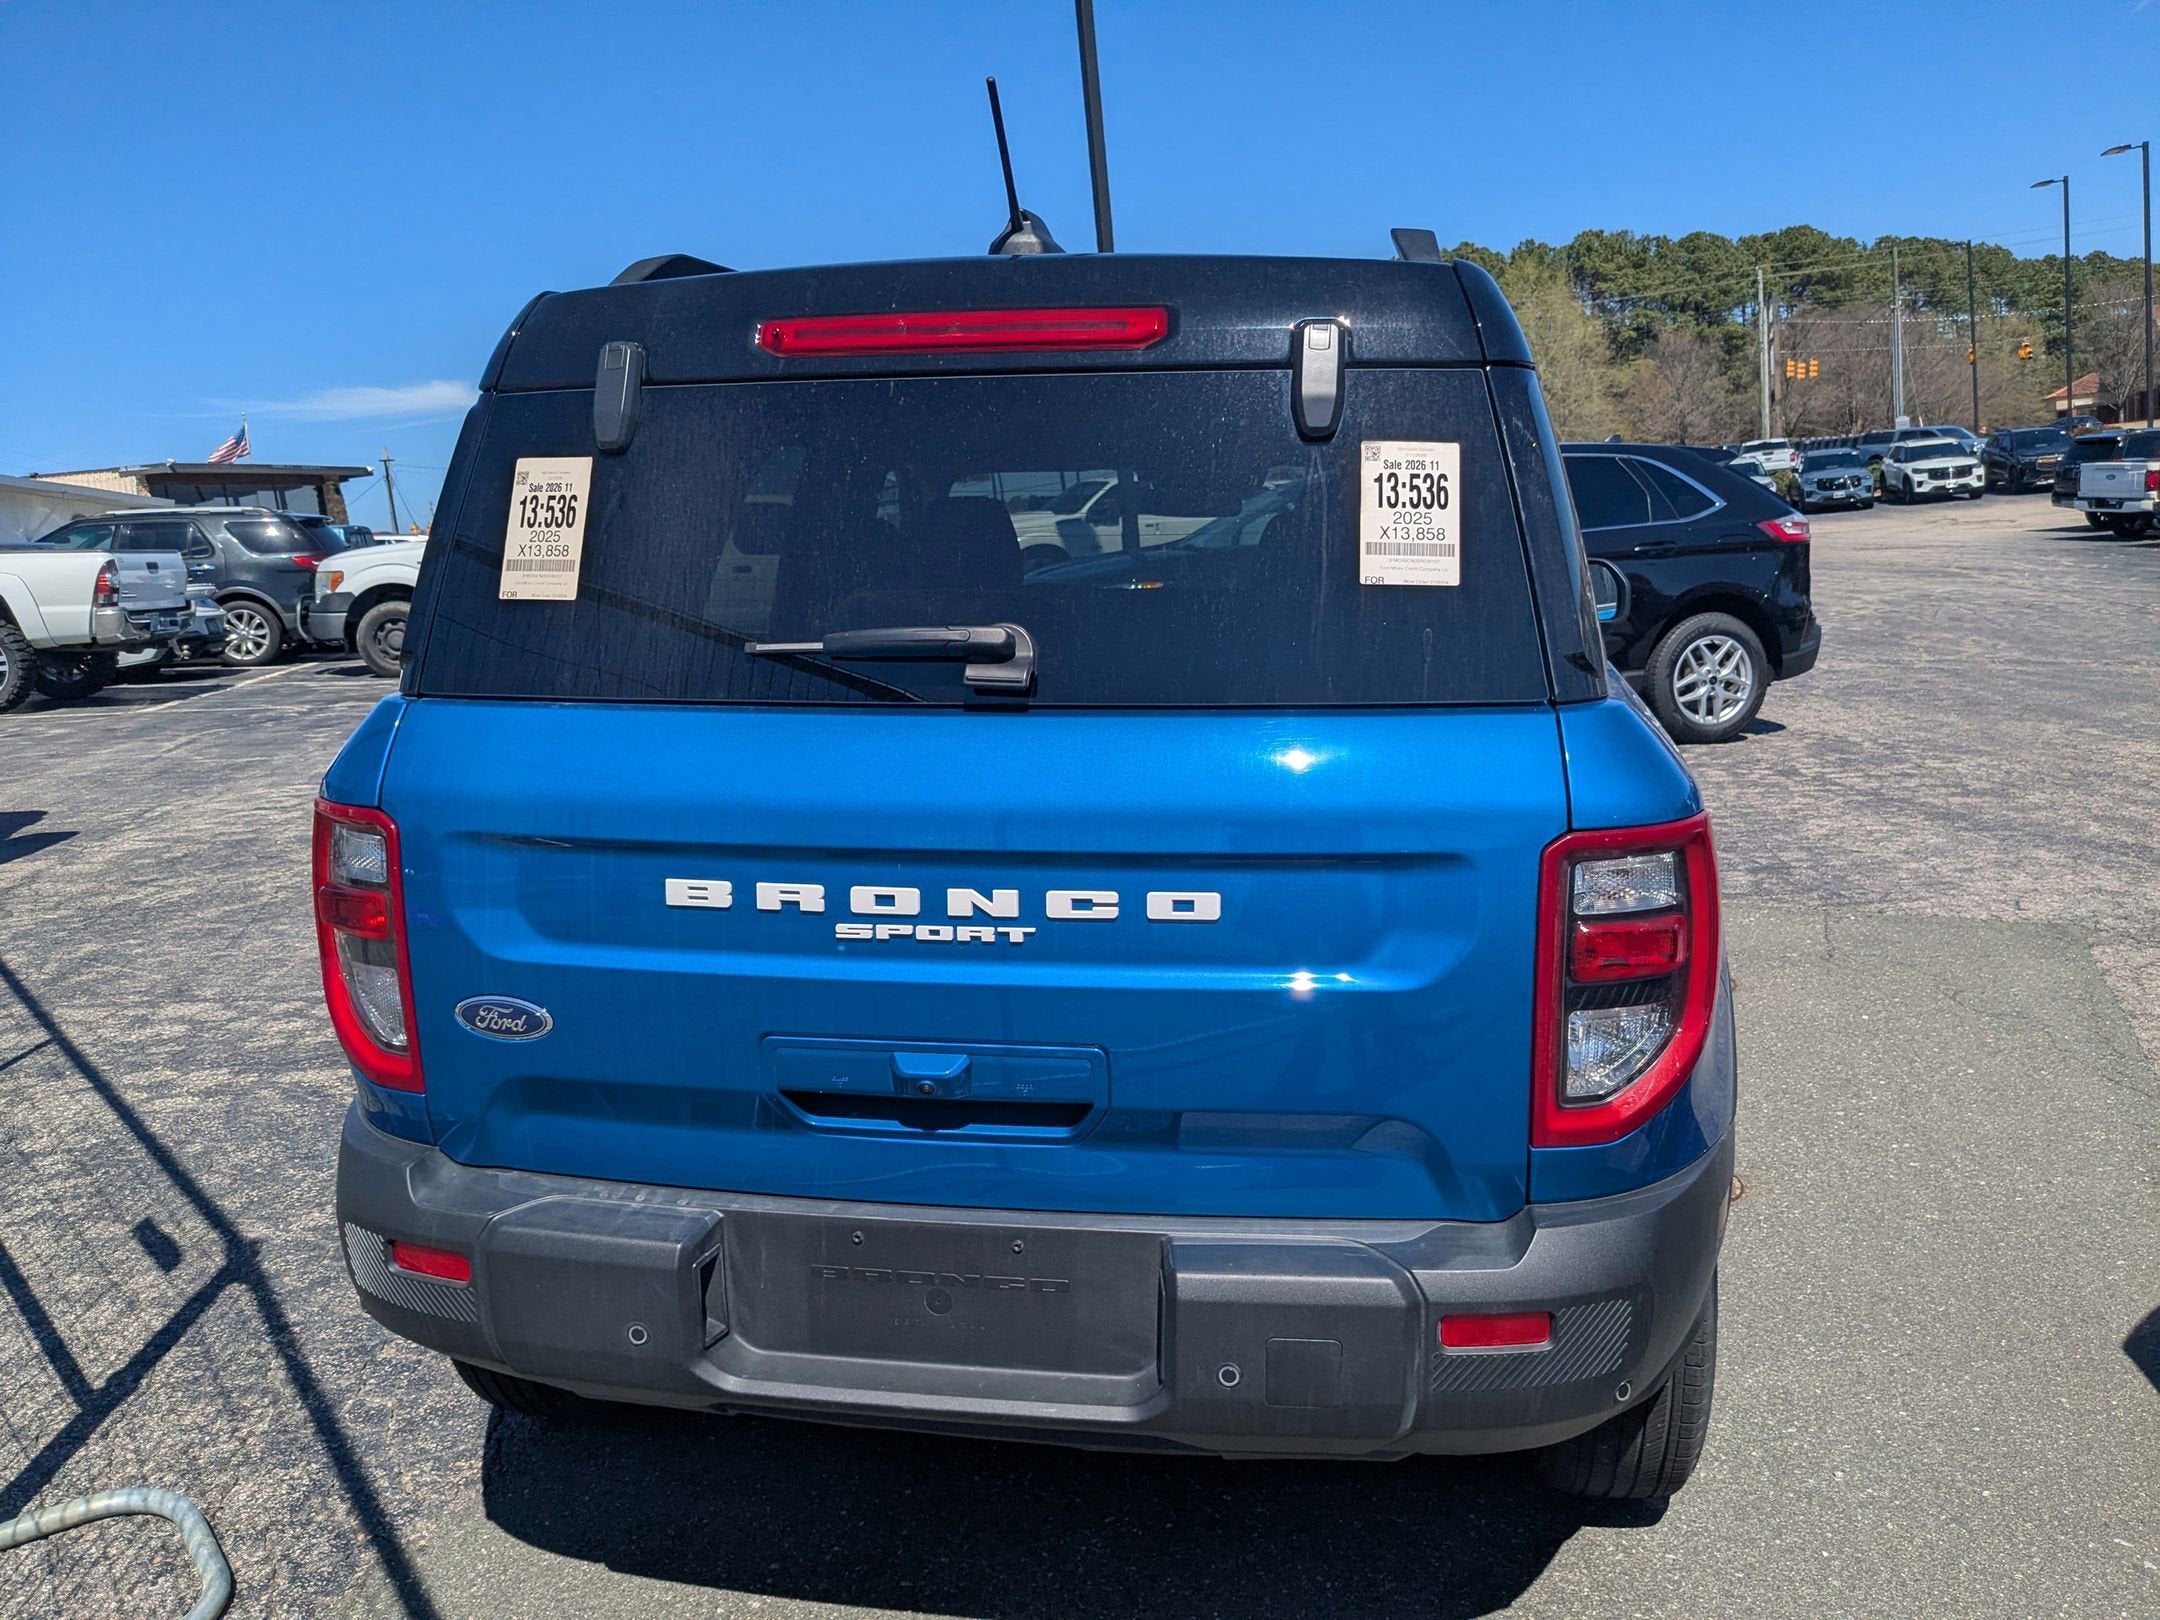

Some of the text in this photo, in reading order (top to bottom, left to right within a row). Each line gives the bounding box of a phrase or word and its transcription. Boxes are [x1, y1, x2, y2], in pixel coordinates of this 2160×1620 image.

[1383, 460, 1439, 471] Sale 2026 11
[528, 483, 573, 492] Sale 2026 11
[1373, 472, 1449, 510] 13:536
[519, 494, 578, 529] 13:536
[1393, 511, 1433, 525] 2025
[529, 530, 561, 543] 2025
[1379, 526, 1446, 542] X13,858
[517, 544, 570, 558] X13,858
[1364, 576, 1385, 584] FOR
[665, 878, 1221, 921] BRONCO
[835, 923, 1036, 943] SPORT
[475, 1005, 527, 1031] Ford
[810, 1264, 1070, 1293] BRONCO
